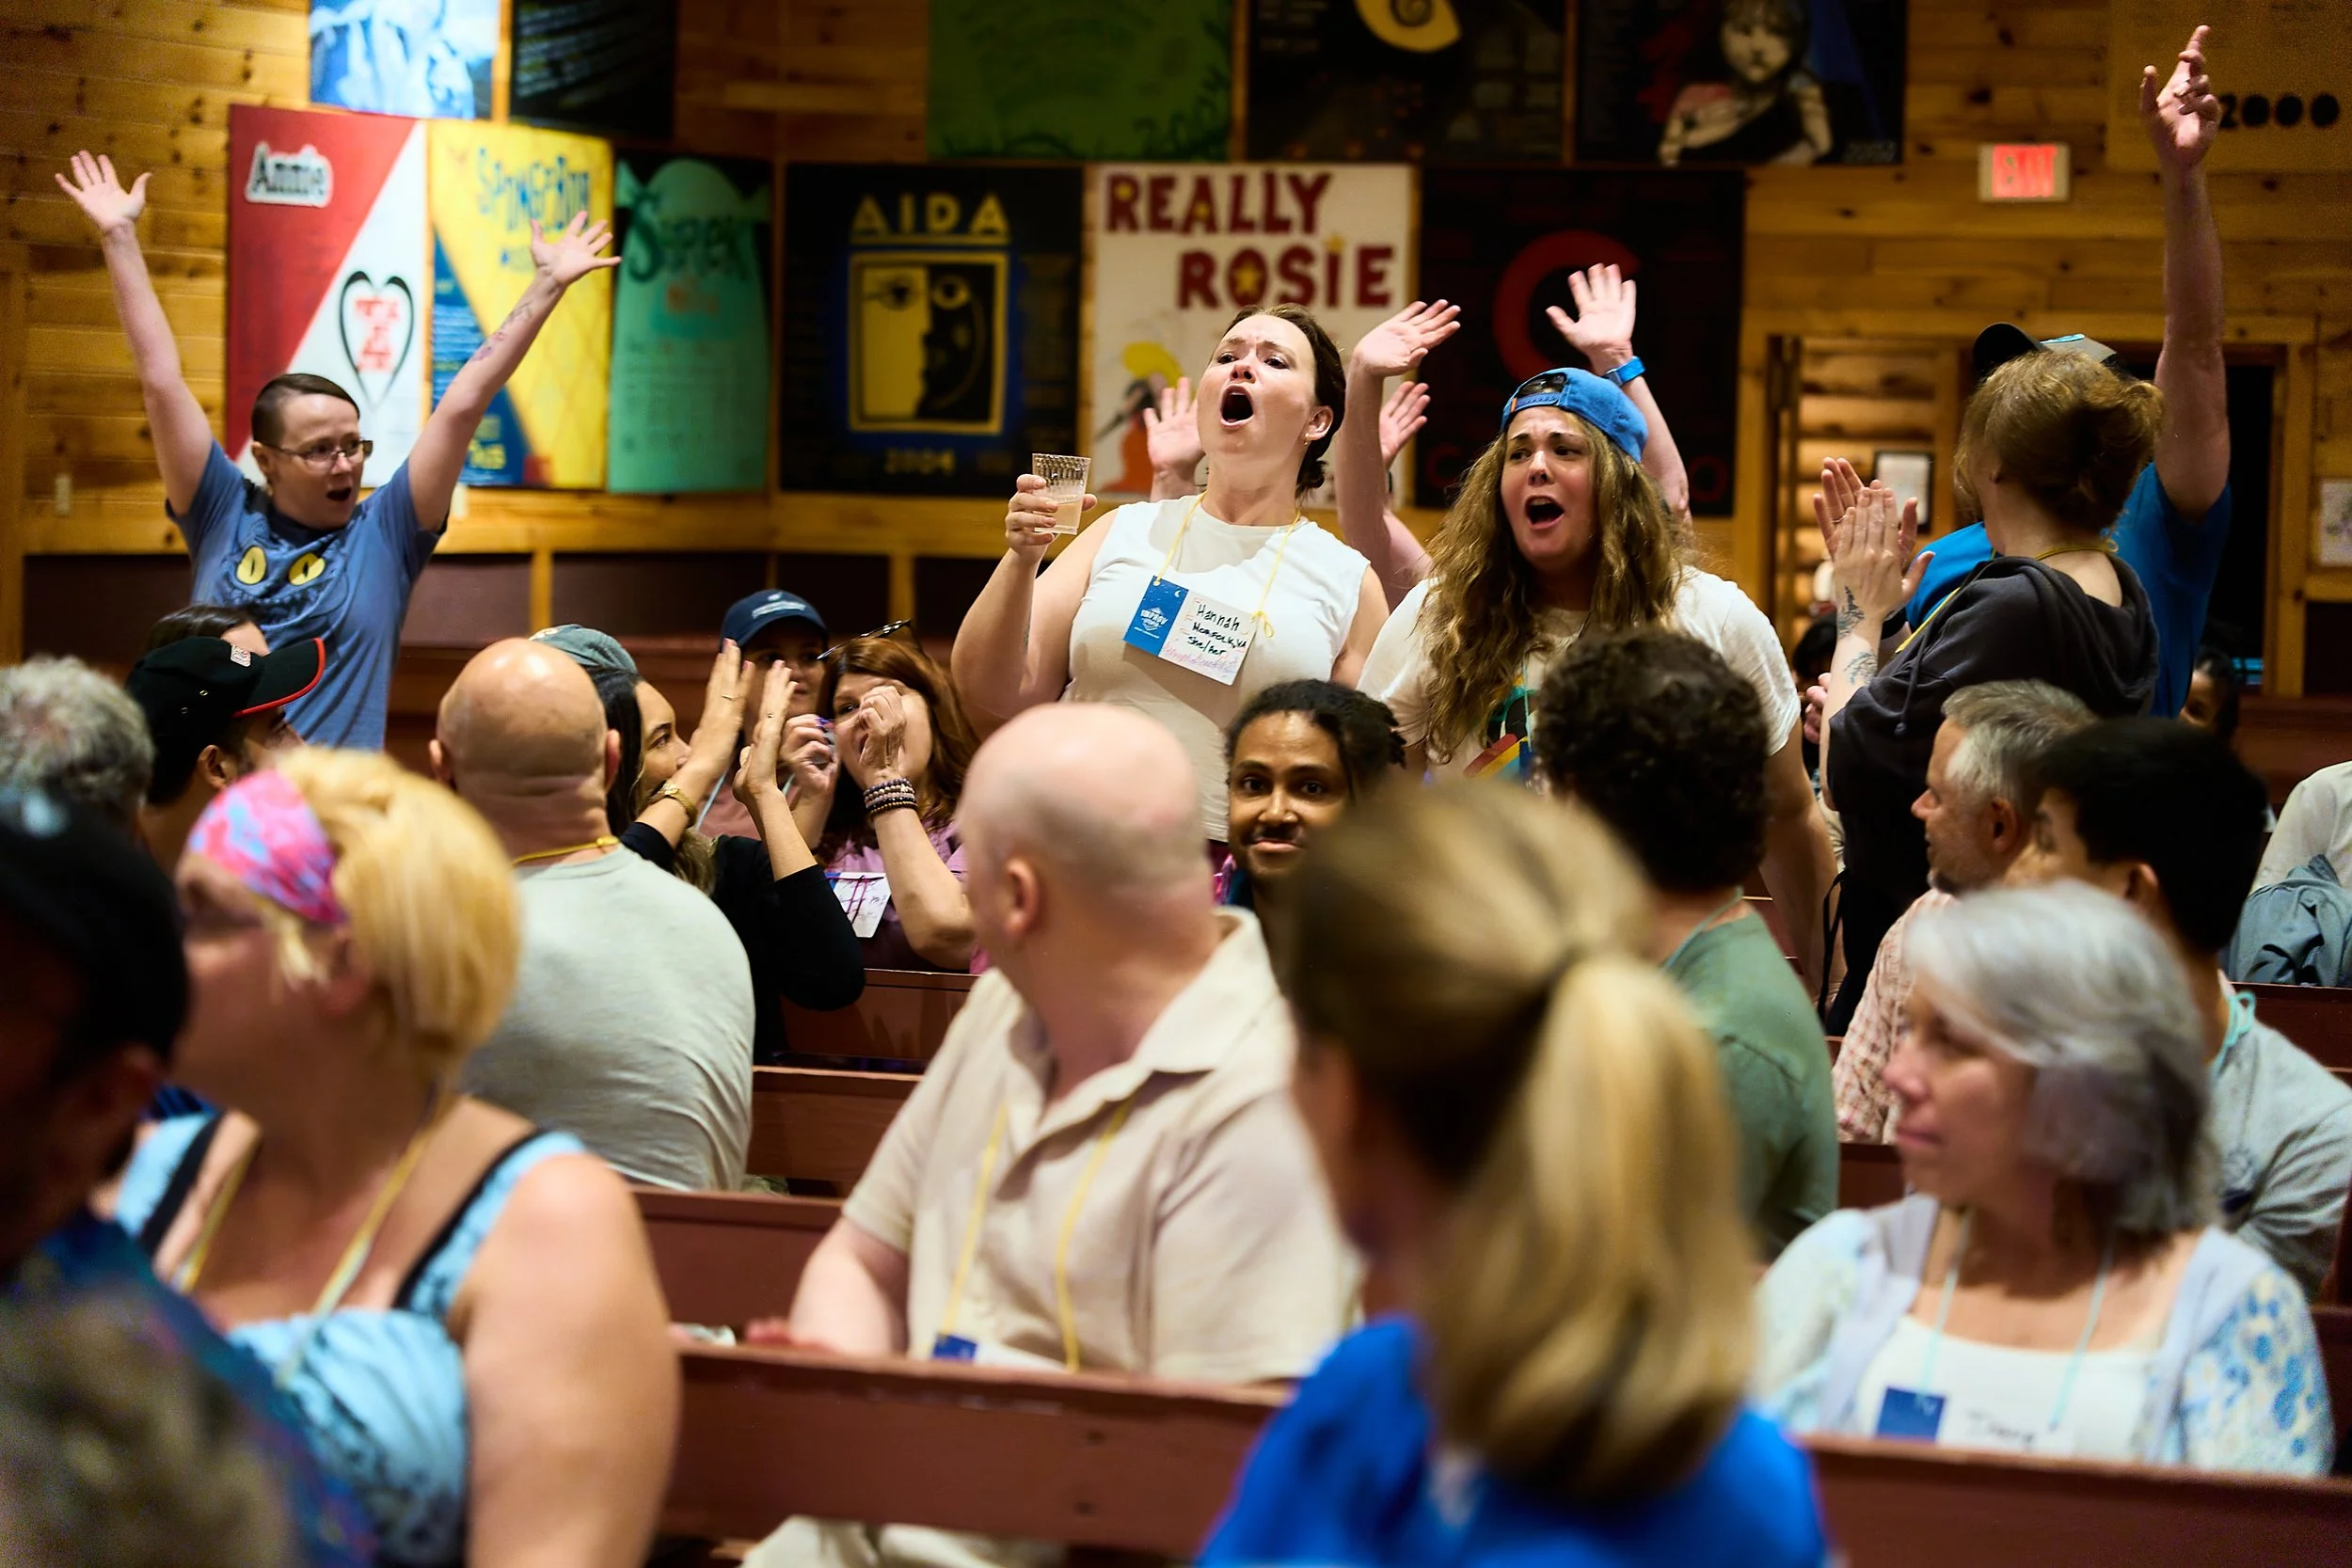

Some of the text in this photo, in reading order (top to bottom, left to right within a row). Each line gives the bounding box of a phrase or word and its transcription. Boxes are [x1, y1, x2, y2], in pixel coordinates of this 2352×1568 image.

[850, 192, 1010, 236] AIDA
[1106, 173, 1332, 234] REALLY
[1197, 604, 1240, 631] Hannah
